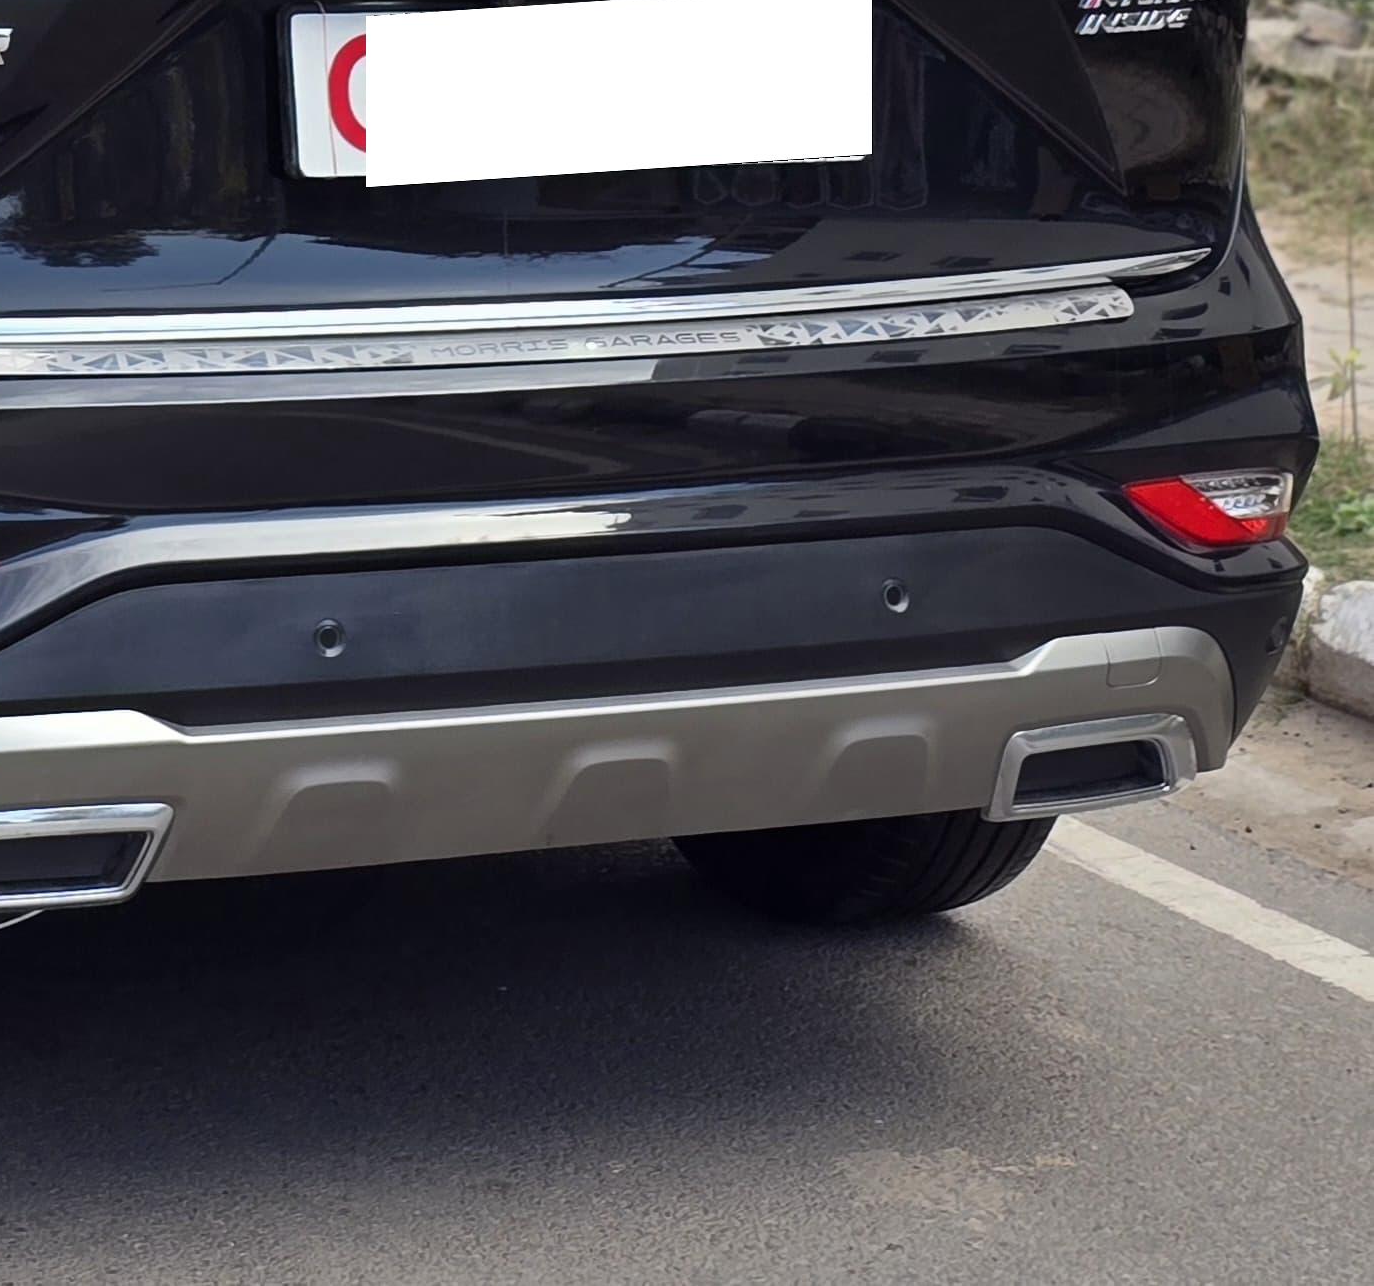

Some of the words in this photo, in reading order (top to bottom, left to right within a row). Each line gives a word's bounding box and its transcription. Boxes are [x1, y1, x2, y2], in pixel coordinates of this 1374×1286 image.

[1074, 7, 1193, 35] INSIDE
[429, 337, 570, 358] MORRIS
[583, 330, 742, 350] GARAGES
